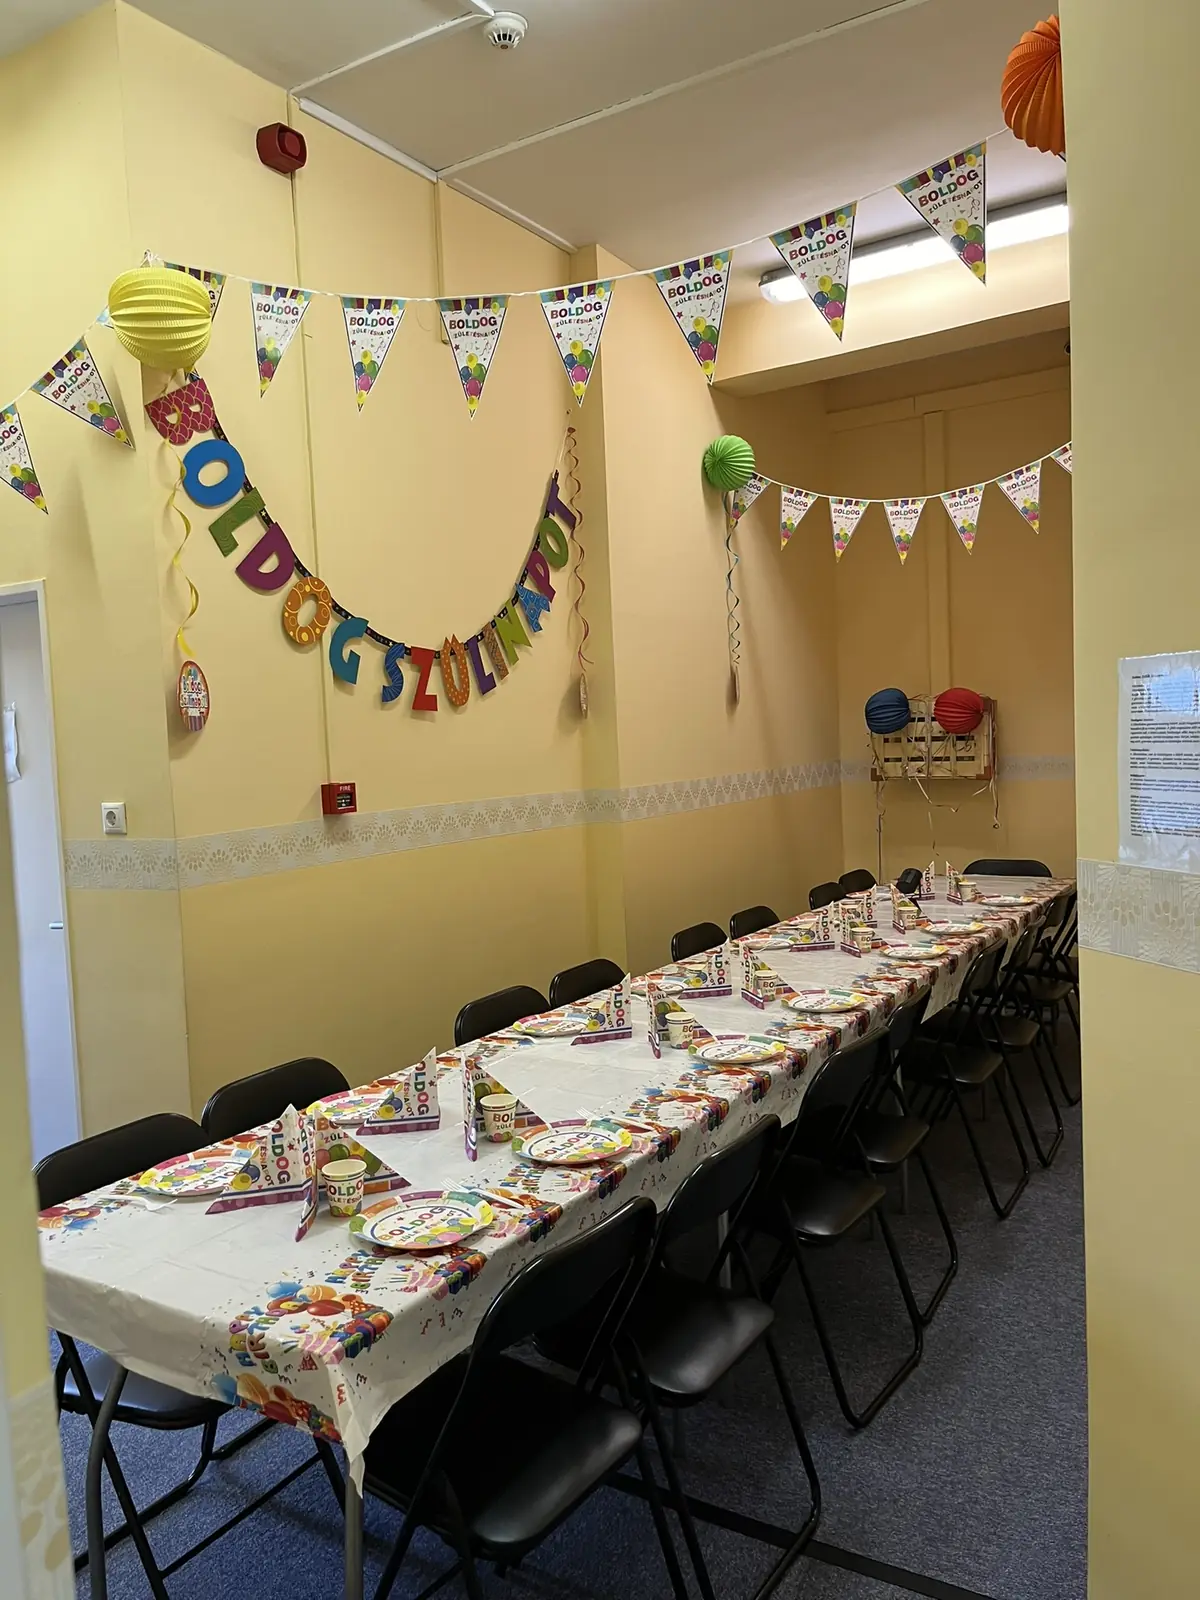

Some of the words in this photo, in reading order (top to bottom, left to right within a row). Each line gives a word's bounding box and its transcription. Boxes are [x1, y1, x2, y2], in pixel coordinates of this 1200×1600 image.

[918, 170, 979, 207] BOLDOG
[789, 229, 847, 260] BOLDOG
[668, 273, 723, 299] BOLDOG
[256, 302, 300, 316] BOLDOG
[550, 302, 603, 319] BOLDOG
[350, 316, 395, 328] BOLDOG
[449, 316, 498, 329] BOLDOG
[52, 361, 91, 400] BOLDOG
[1006, 474, 1037, 491] BOLDOG
[948, 496, 979, 509] BOLDOG
[833, 508, 860, 516] BOLDOG
[889, 508, 919, 517] BOLDOG
[144, 378, 369, 684] BOLDOG
[378, 1206, 446, 1241] BOLDOG
